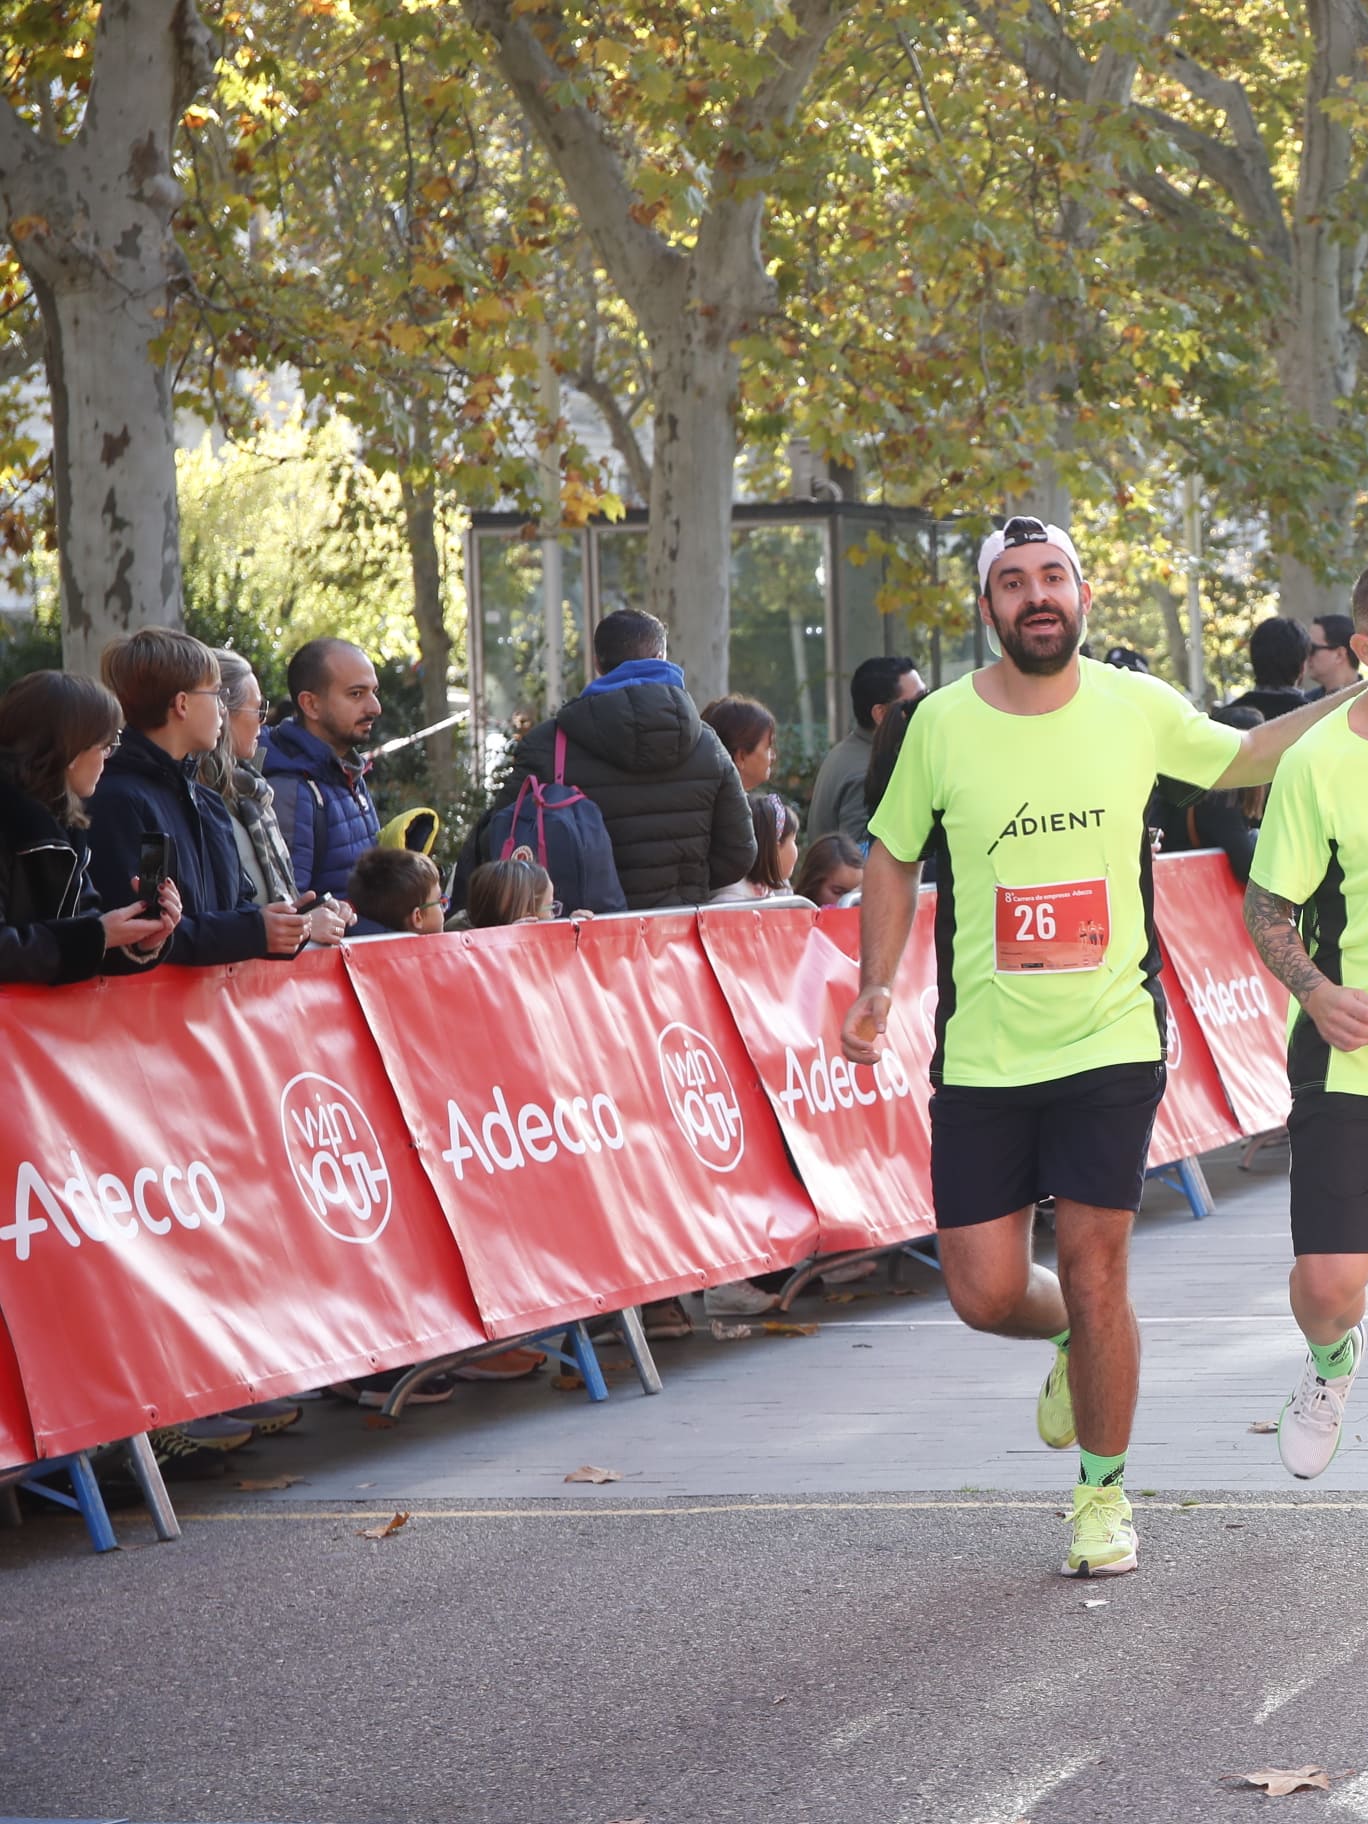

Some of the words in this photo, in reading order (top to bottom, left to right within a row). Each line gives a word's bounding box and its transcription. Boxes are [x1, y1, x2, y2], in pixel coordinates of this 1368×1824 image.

[988, 803, 1106, 850] ADIENT
[1014, 903, 1057, 942] 26
[1189, 967, 1271, 1028] Adecco
[779, 1037, 909, 1119] Adecco
[441, 1085, 624, 1181] Adecco
[0, 1150, 226, 1261] Adecco
